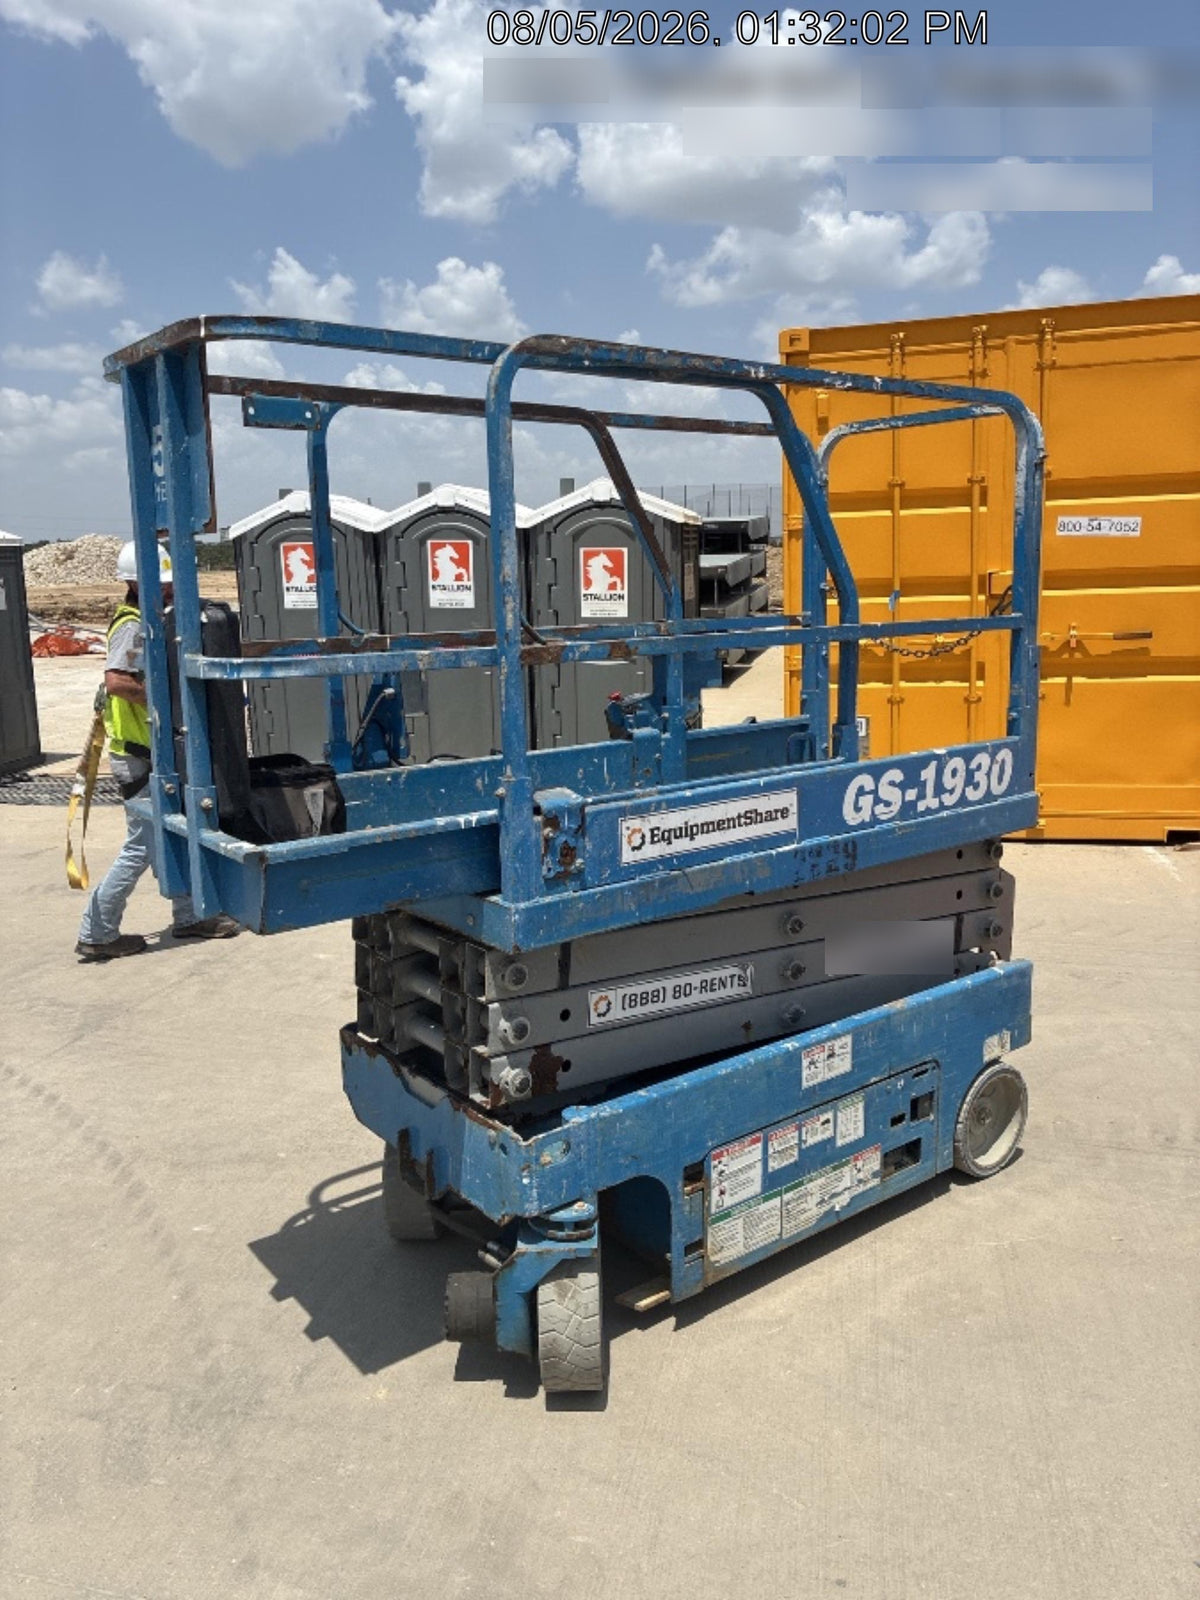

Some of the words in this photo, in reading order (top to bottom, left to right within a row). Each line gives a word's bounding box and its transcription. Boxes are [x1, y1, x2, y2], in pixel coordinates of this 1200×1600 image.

[431, 584, 472, 593] STALLION
[582, 593, 625, 602] STALLION
[842, 748, 1014, 826] GS-1930
[650, 806, 790, 846] EquipmentShare
[621, 986, 667, 1011] (888)
[671, 973, 749, 1000] 80-RENTS
